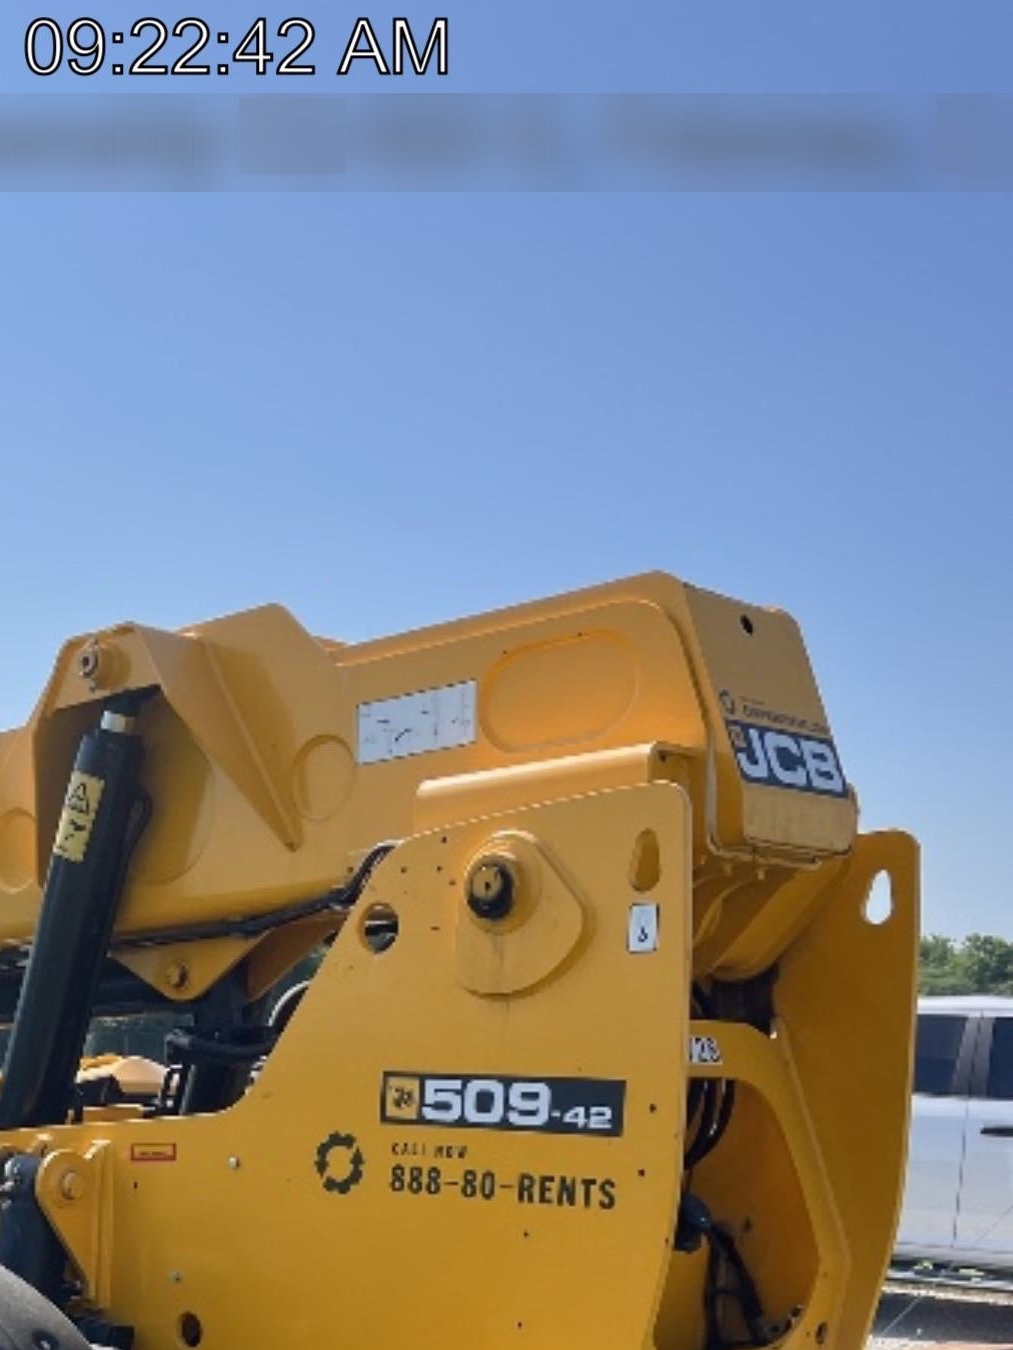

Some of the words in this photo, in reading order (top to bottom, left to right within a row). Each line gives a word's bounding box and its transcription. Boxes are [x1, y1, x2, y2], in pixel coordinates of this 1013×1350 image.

[736, 726, 844, 794] JCB
[421, 1079, 612, 1130] 509-42
[390, 1163, 617, 1211] 888-80-RENTS
